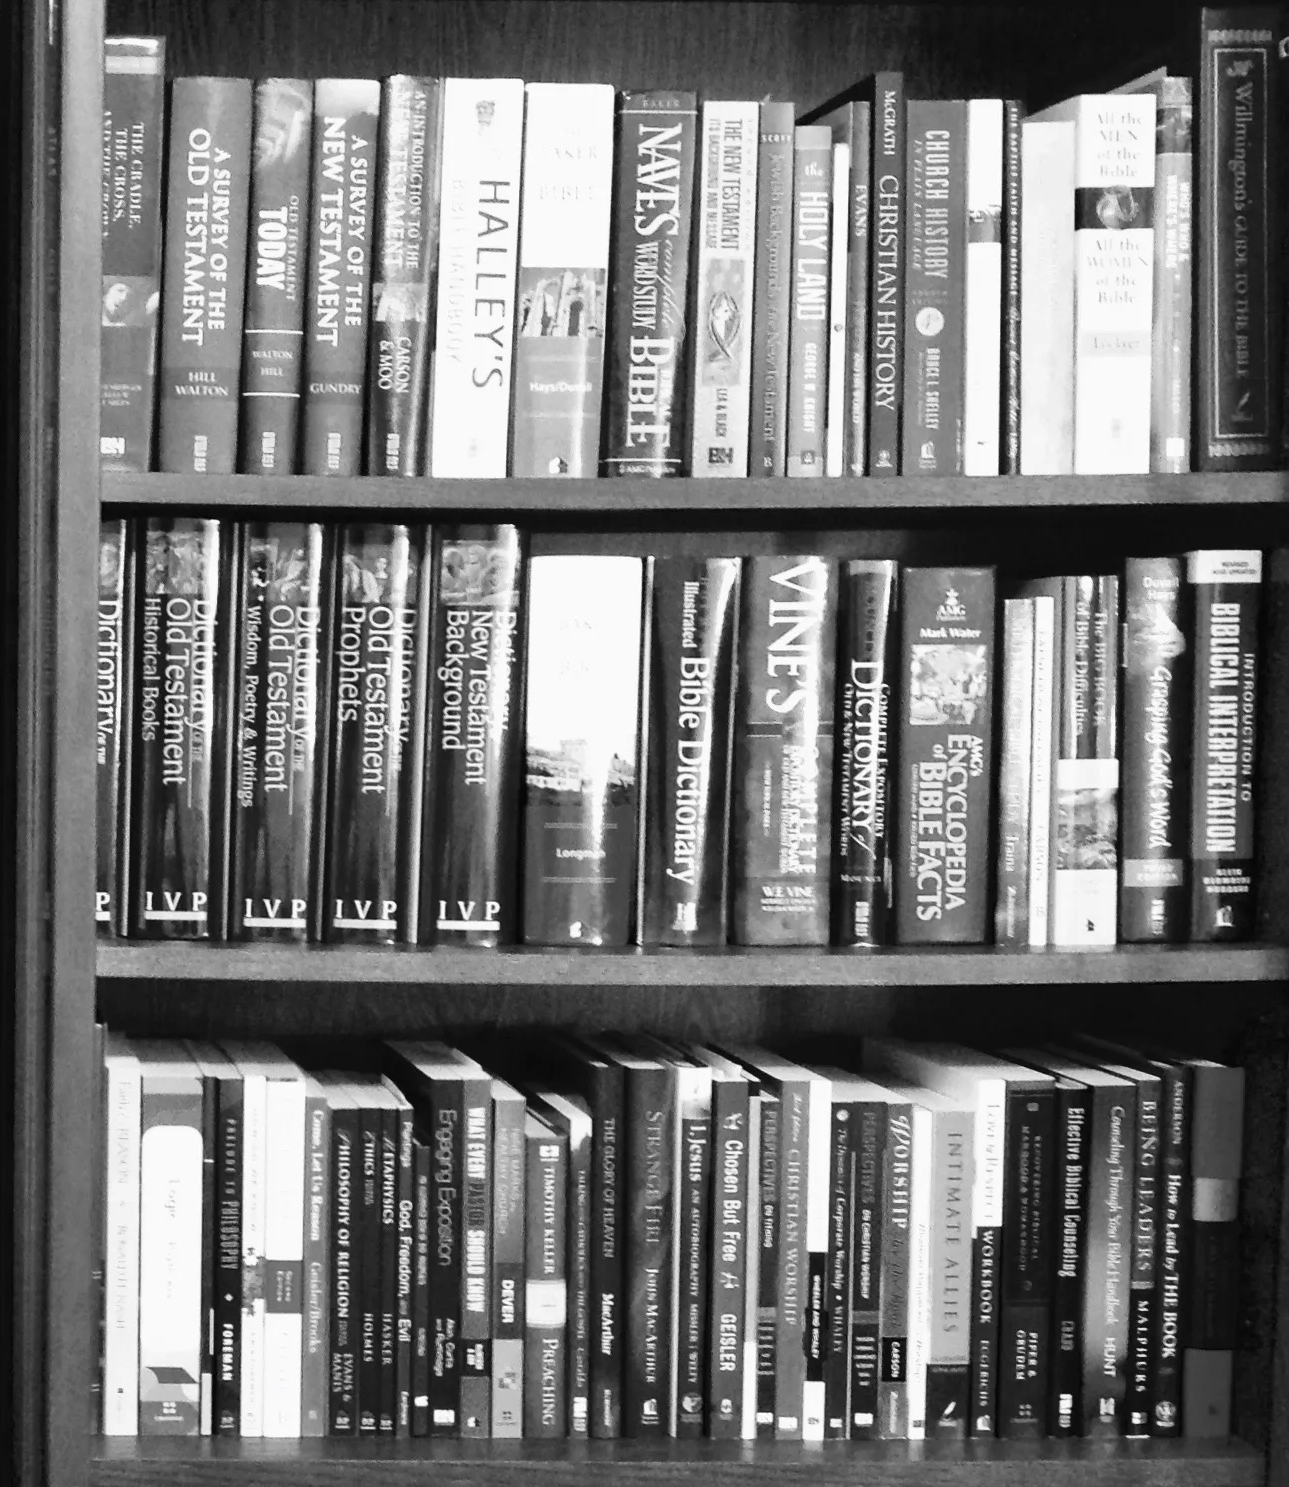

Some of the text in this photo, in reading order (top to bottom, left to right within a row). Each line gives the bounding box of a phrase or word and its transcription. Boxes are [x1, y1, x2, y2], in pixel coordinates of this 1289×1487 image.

[181, 127, 212, 347] OLD TESTAMENT
[207, 147, 232, 330] A SURVEY OF THE
[256, 206, 287, 291] TODAY
[316, 116, 347, 348] NEW TESTAMENT
[344, 134, 369, 327] A SURVEY OF THE
[796, 191, 829, 320] HOLY LAND
[924, 129, 950, 278] CHURCH HISTORY
[471, 180, 511, 388] HALLEY'S
[875, 175, 900, 411] CHRISTIAN HISTORY
[175, 385, 229, 397] WALTON
[188, 371, 216, 383] HILL
[310, 383, 362, 395] GUNDRY
[378, 354, 394, 390] MOO
[394, 336, 411, 393] CARSON
[142, 598, 162, 742] Historical Books
[162, 598, 192, 785] Old Testament
[242, 675, 260, 723] Poetry
[264, 605, 295, 793] Old Testament
[336, 606, 366, 722] Prophets
[361, 606, 394, 795] Old Testament
[437, 610, 470, 750] Background
[465, 611, 495, 786] New Testament
[1209, 603, 1240, 688] BIBLICAL
[666, 581, 711, 885] Illustrated Bible Dictionary
[1205, 695, 1239, 852] INTERPRETATION
[1240, 654, 1256, 801] INTRODUCTION TO
[916, 762, 949, 921] BIBLE FACTS
[945, 734, 972, 911] ENCYCLOPEDIA
[543, 1168, 556, 1275] TIMOTHY KELLER
[719, 1139, 744, 1372] Chosen But Free GEISLER
[943, 1131, 963, 1333] INTIMATE ALLIES
[1057, 1107, 1085, 1278] Effective Biblical Counseling
[1137, 1101, 1158, 1272] BEING LEADERS
[337, 1228, 350, 1318] OF RELIGION
[397, 1318, 412, 1342] Evil
[466, 1229, 486, 1313] SHOULD KNOW
[501, 1279, 515, 1324] DEVER
[979, 1229, 995, 1324] WORKBOOK
[1161, 1174, 1182, 1359] How Lead THE BOOK
[541, 1338, 560, 1427] PREACHING
